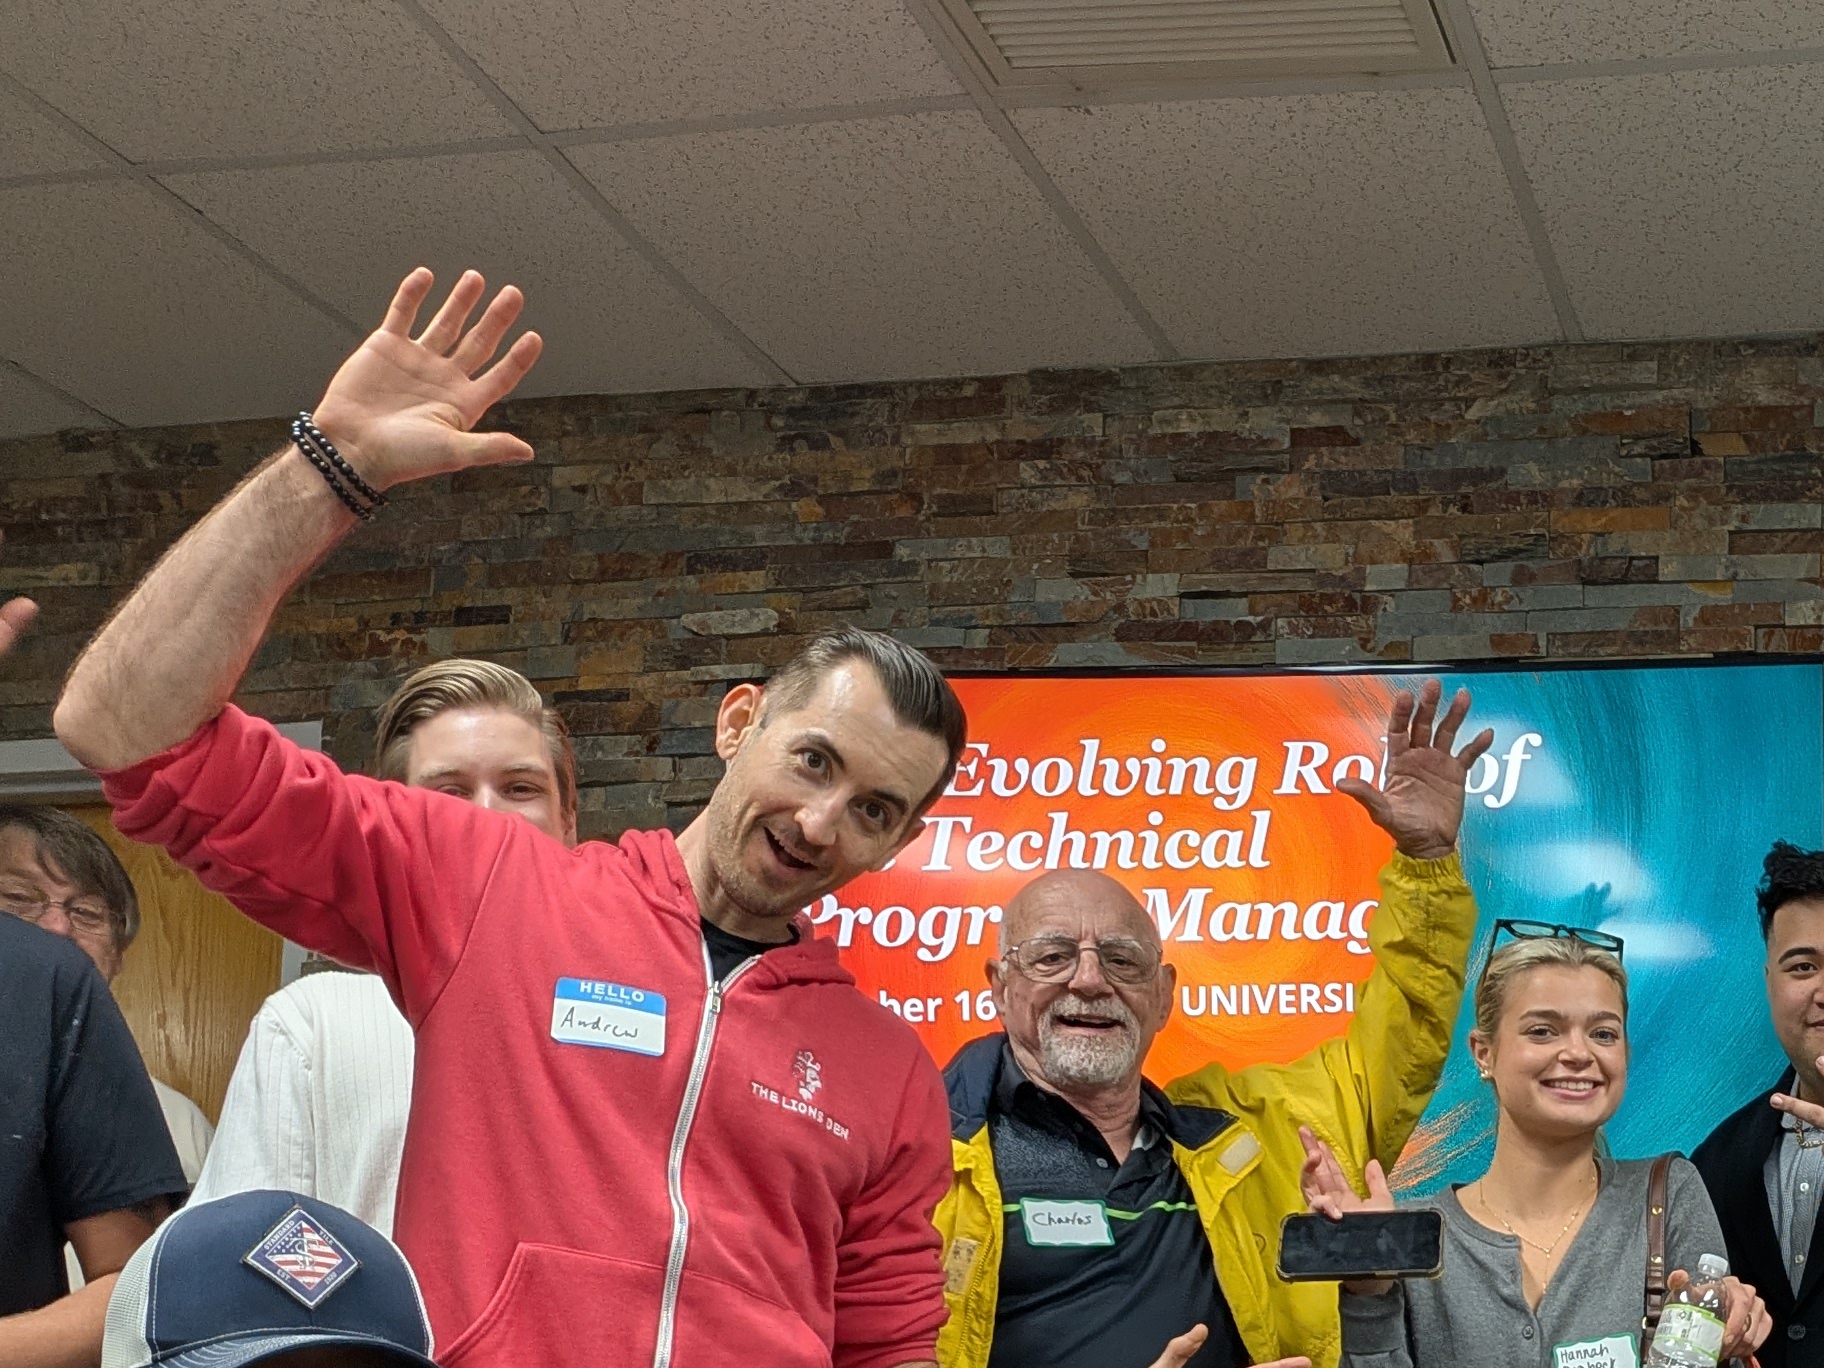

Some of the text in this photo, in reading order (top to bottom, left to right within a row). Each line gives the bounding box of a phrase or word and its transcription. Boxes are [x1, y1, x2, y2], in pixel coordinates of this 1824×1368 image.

[944, 733, 1543, 811] Evolving Ro of
[920, 810, 1272, 872] Technical
[802, 887, 1379, 963] rogr Manag
[580, 981, 645, 1003] HELLO
[879, 982, 1355, 1022] ber 16 UNIVERSI
[560, 1006, 639, 1038] Andrew
[751, 1081, 850, 1140] THE LIONS DEN
[263, 1220, 295, 1251] STANDARD
[1560, 1344, 1610, 1364] Hannah
